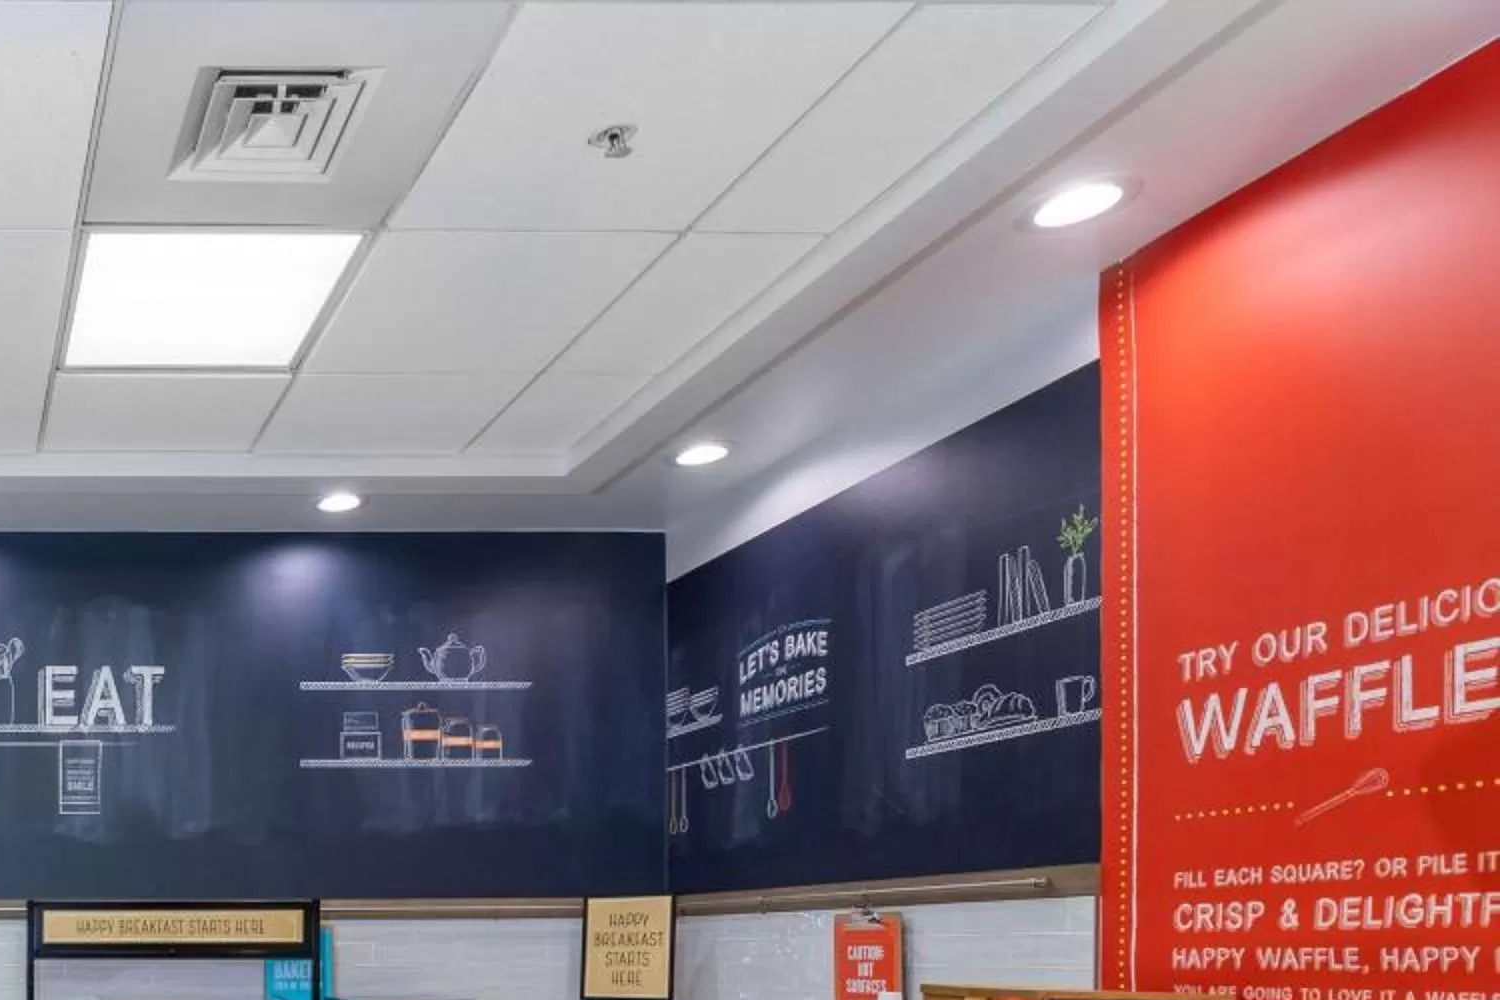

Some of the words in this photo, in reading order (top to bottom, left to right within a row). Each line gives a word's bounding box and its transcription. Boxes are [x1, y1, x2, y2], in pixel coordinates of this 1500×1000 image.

[1177, 640, 1238, 683] TRY
[1252, 621, 1328, 667] OUR
[1344, 577, 1500, 648] DELICIO
[739, 639, 779, 686] LET'S
[785, 630, 829, 661] BAKE
[38, 665, 165, 730] EAT
[739, 666, 828, 718] MEMORIES
[1176, 636, 1500, 764] WAFFLE
[1173, 869, 1207, 889] FILL
[1214, 864, 1264, 888] EACH
[1270, 857, 1366, 885] SQUARE?
[1373, 856, 1408, 879] OR
[1416, 852, 1469, 878] PILE
[1477, 850, 1500, 874] IT
[76, 919, 114, 935] HAPPY
[118, 919, 184, 936] BREAKFAST
[188, 919, 232, 936] STARTS
[235, 919, 267, 936] HERE
[609, 912, 650, 928] HAPPY
[1173, 900, 1266, 933] CRISP
[1277, 898, 1300, 931] &
[1313, 890, 1500, 932] DELIGHTF
[593, 931, 665, 948] BREAKFAST
[604, 950, 651, 969] STARTS
[611, 970, 643, 987] HERE
[1171, 946, 1246, 971] HAPPY
[1256, 946, 1370, 975] WAFFLE,
[1380, 945, 1482, 975] HAPPY
